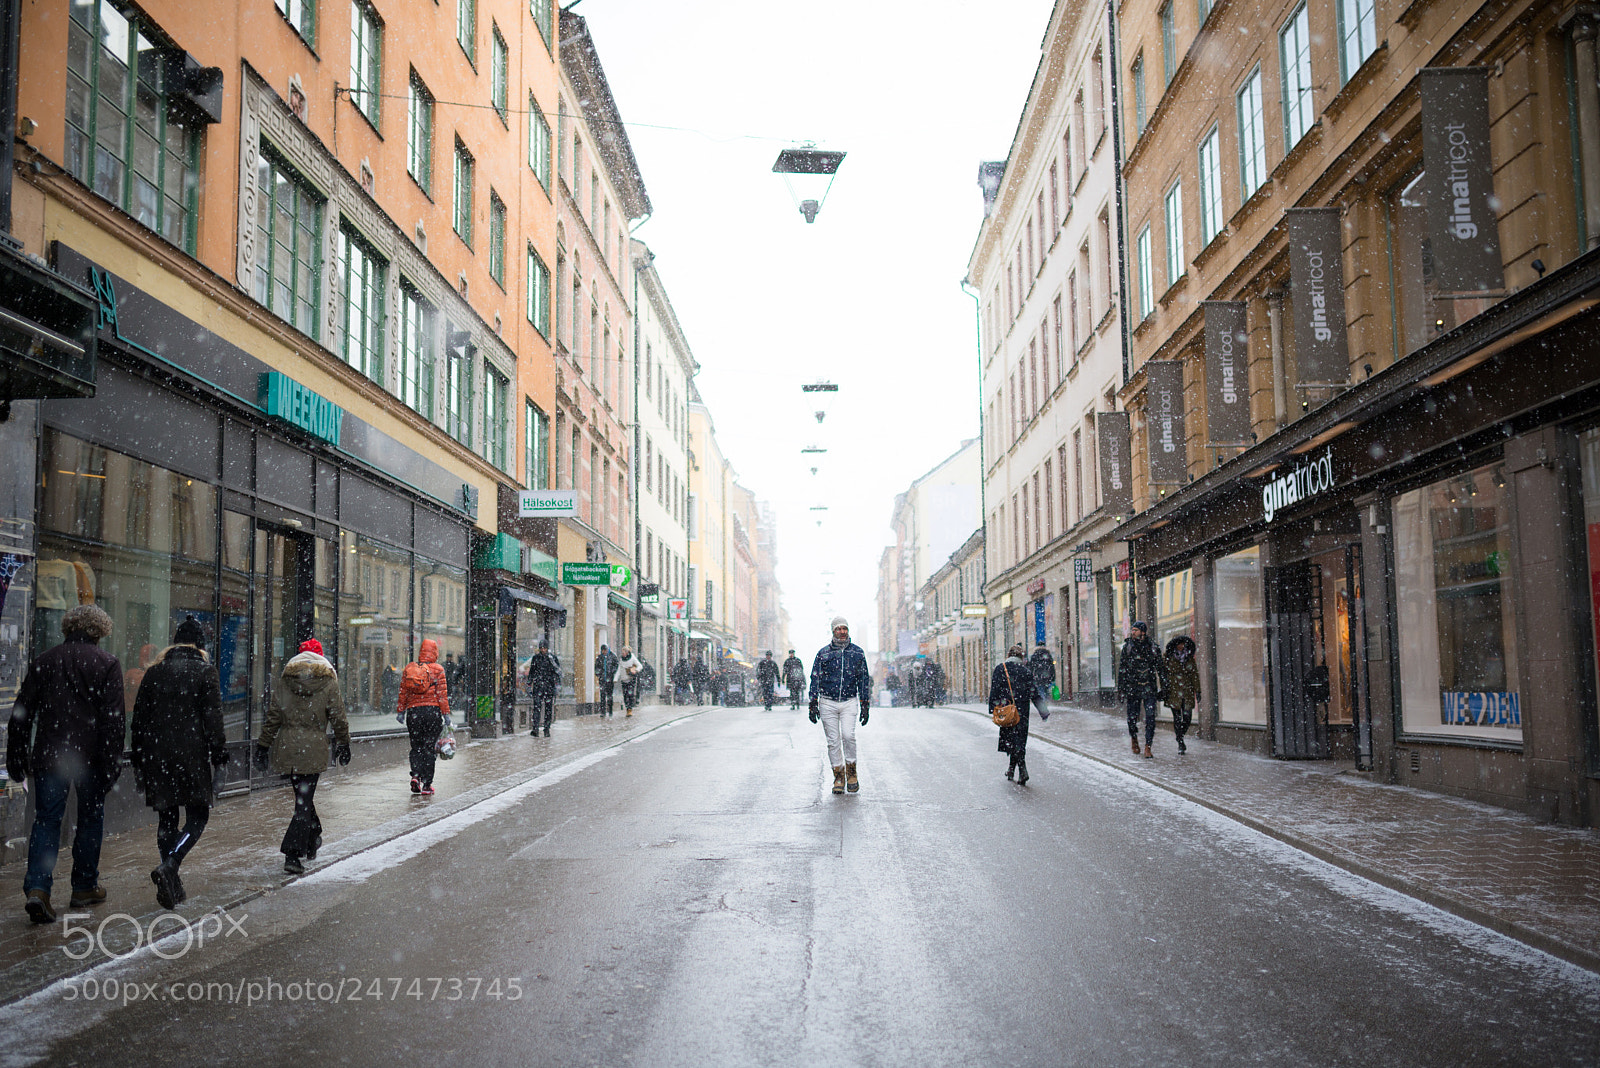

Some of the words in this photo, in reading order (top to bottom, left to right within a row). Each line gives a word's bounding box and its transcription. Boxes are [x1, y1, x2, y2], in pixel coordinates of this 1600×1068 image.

[1445, 122, 1478, 241] ginatricot
[1307, 249, 1332, 342] ginatricot
[1217, 329, 1238, 405] ginatricot
[278, 372, 344, 447] WEEKDAY
[1159, 389, 1176, 454] ginatricot
[1109, 436, 1123, 490] ginatricot
[1262, 445, 1335, 523] ginatricot
[522, 497, 574, 508] Hälsokost
